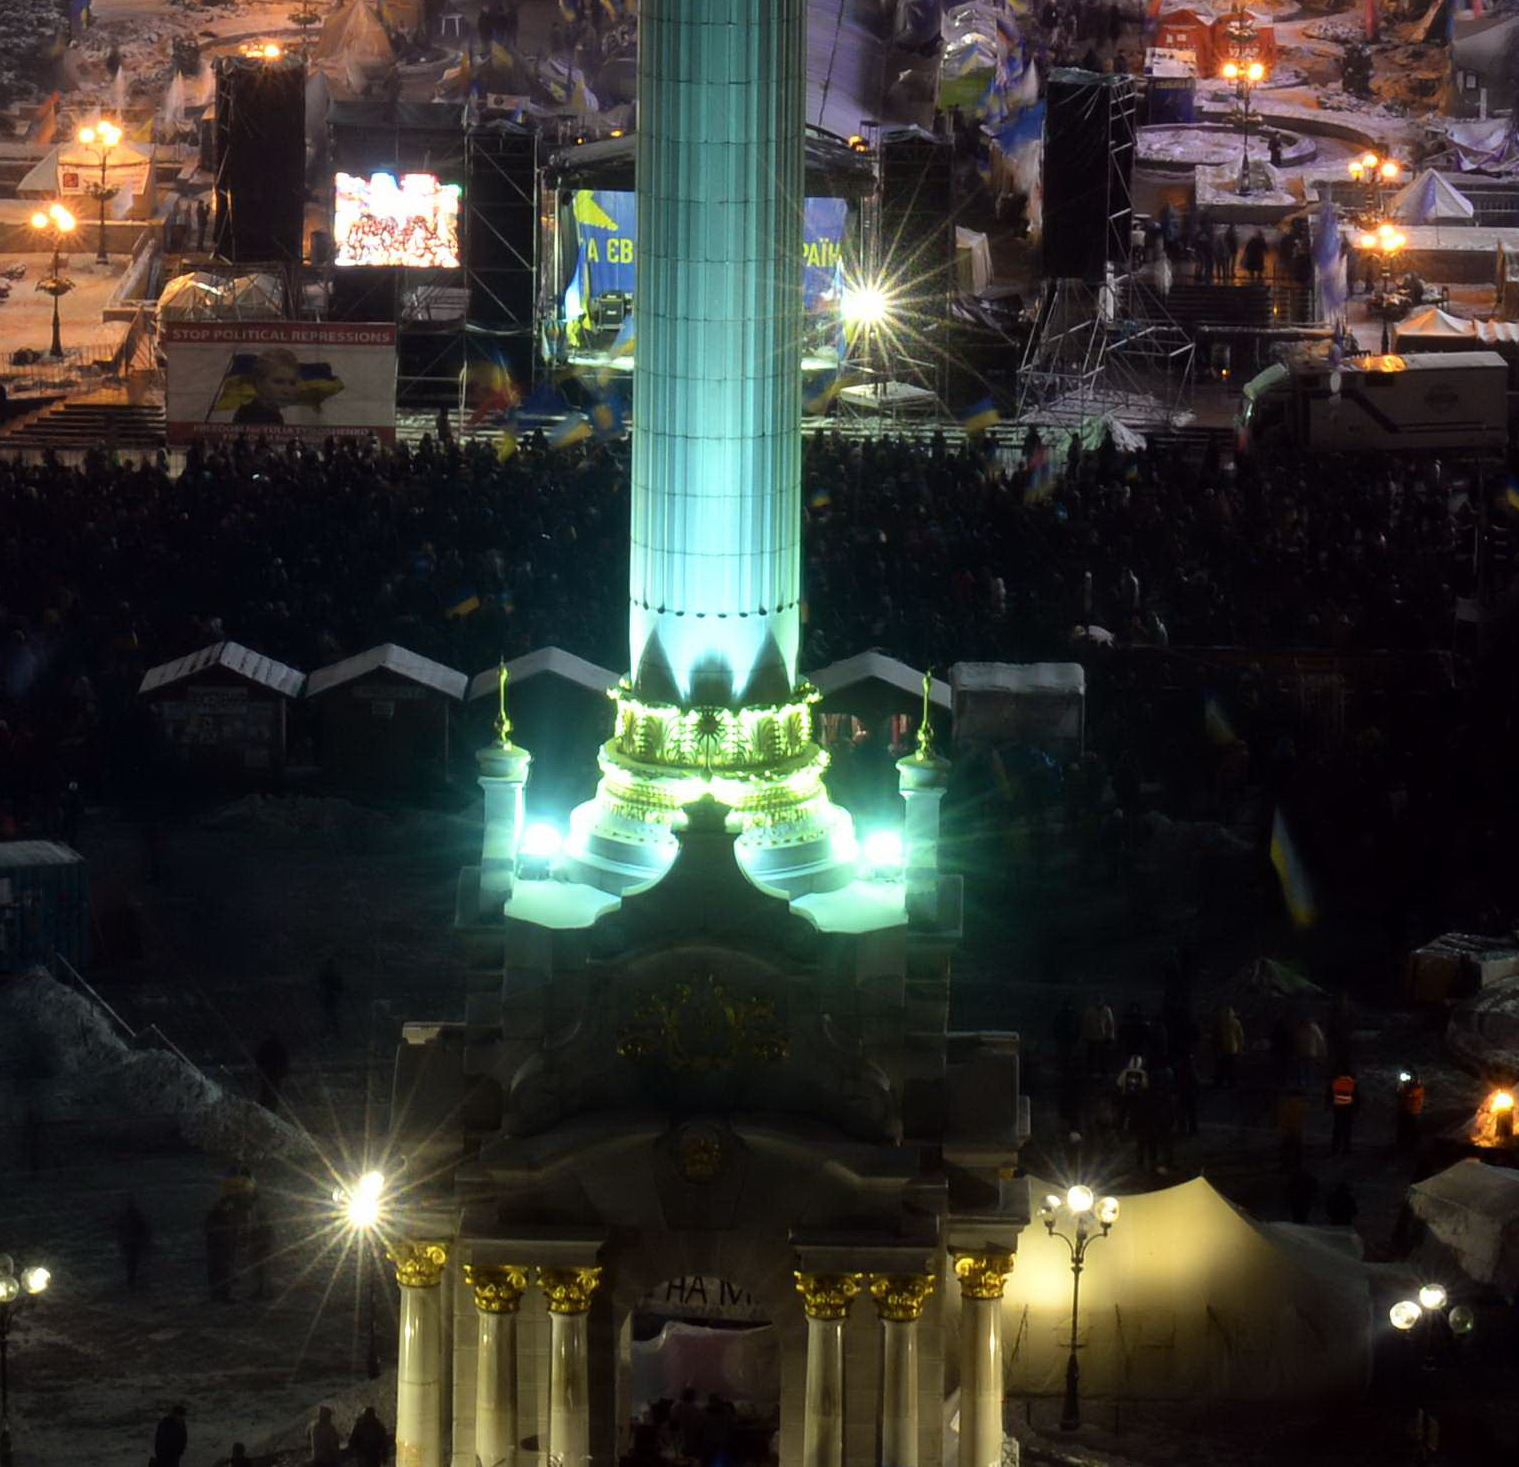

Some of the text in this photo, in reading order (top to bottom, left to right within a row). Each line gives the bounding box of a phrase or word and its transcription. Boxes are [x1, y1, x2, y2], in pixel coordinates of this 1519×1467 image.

[173, 329, 390, 343] STOP POLITICAL REPRESSIONS
